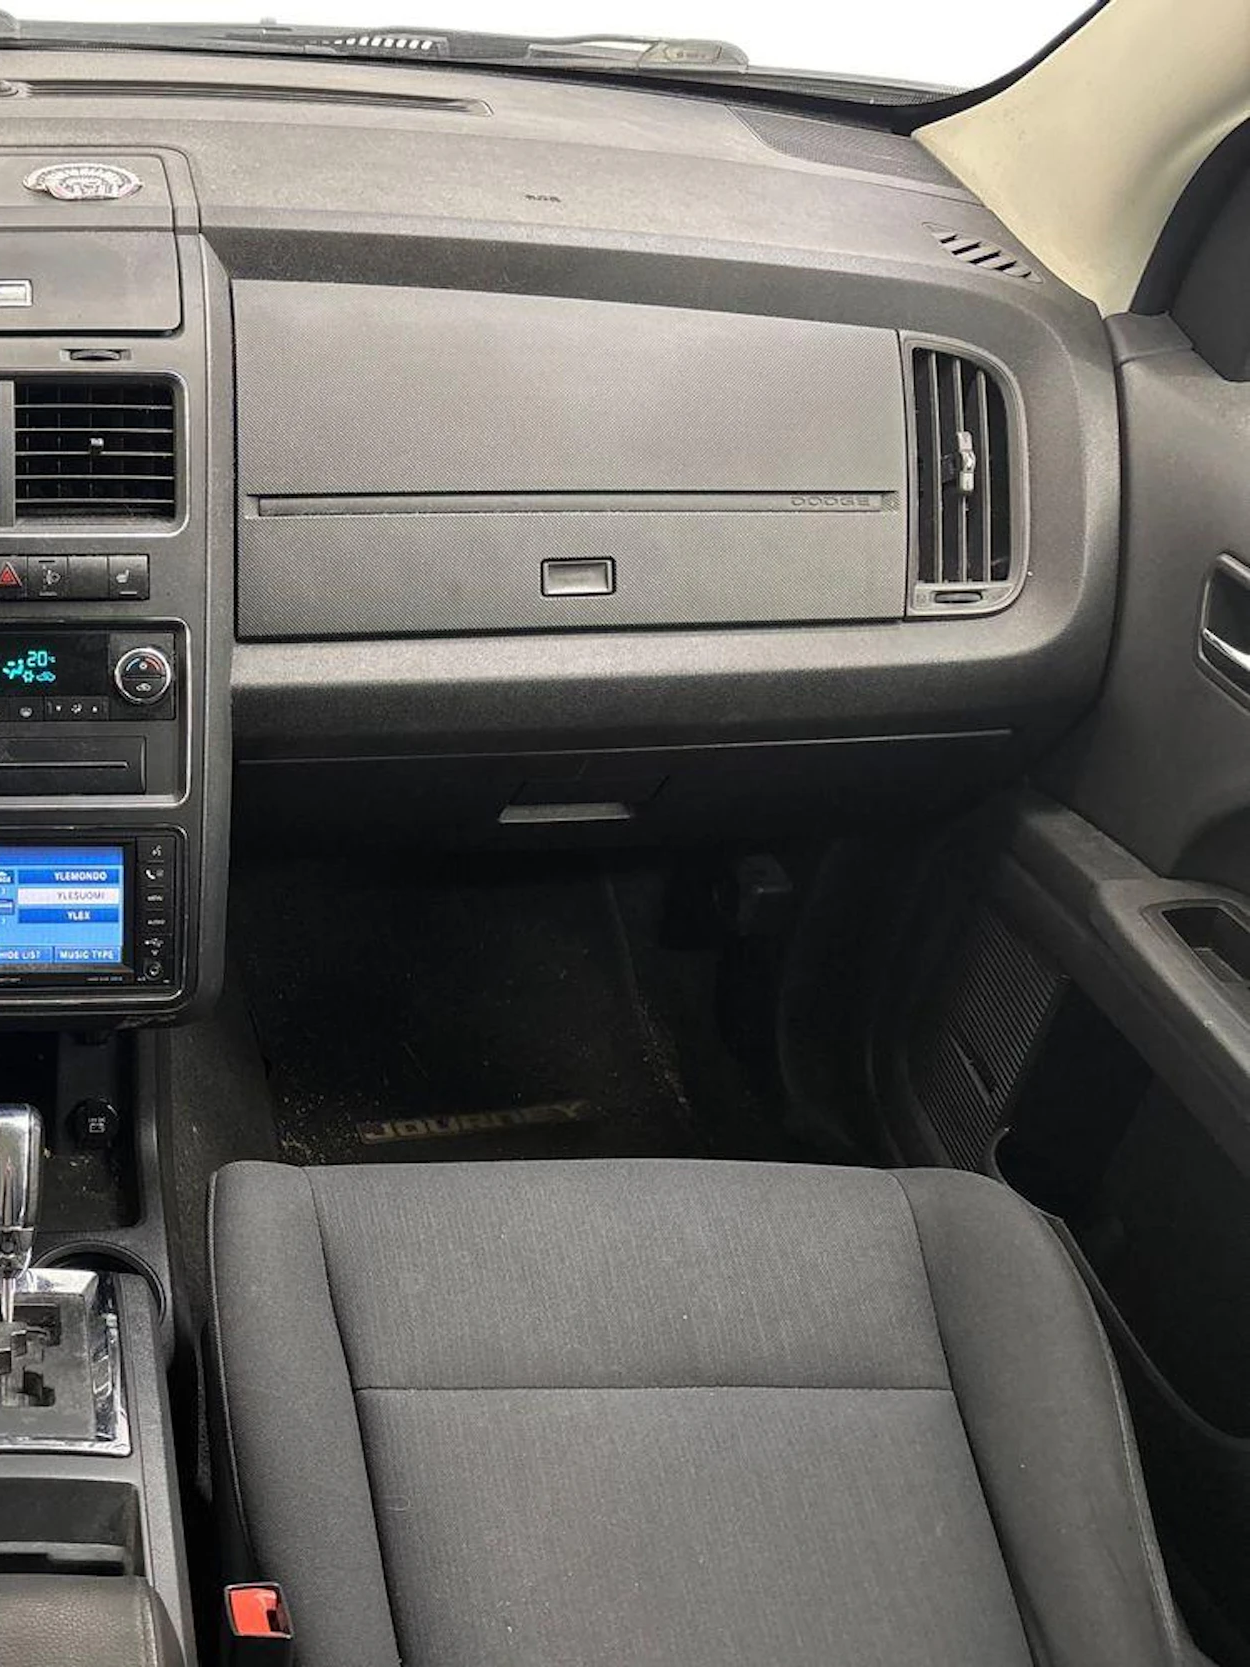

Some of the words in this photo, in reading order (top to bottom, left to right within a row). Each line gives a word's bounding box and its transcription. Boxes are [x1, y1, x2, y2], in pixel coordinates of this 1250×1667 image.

[791, 496, 870, 506] DODGE
[54, 871, 108, 881] YLEMONDO
[57, 891, 105, 901] YLESUOMI
[66, 910, 91, 920] YLEX
[59, 950, 89, 960] MUSIC
[92, 950, 115, 960] TYPE
